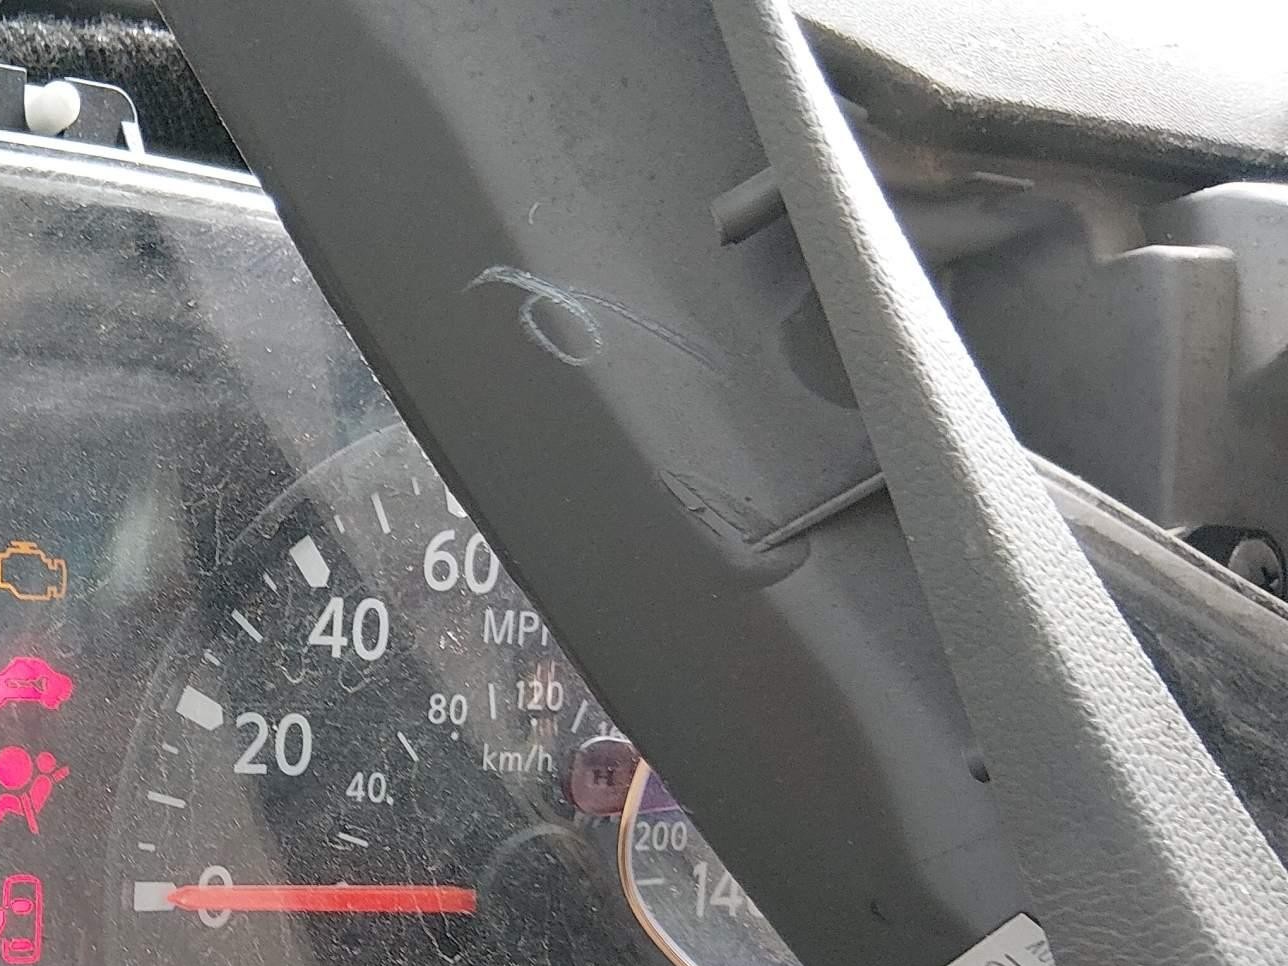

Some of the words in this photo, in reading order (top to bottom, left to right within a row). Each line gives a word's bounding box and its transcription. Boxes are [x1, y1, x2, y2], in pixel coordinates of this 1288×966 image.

[423, 529, 500, 594] 60
[308, 596, 390, 661] 40
[428, 693, 469, 726] 80
[515, 680, 563, 711] 120
[233, 711, 313, 776] 20
[481, 743, 554, 773] km/h
[345, 771, 387, 804] 40
[634, 821, 688, 852] 200
[198, 864, 233, 929] 0
[693, 861, 764, 918] 14
